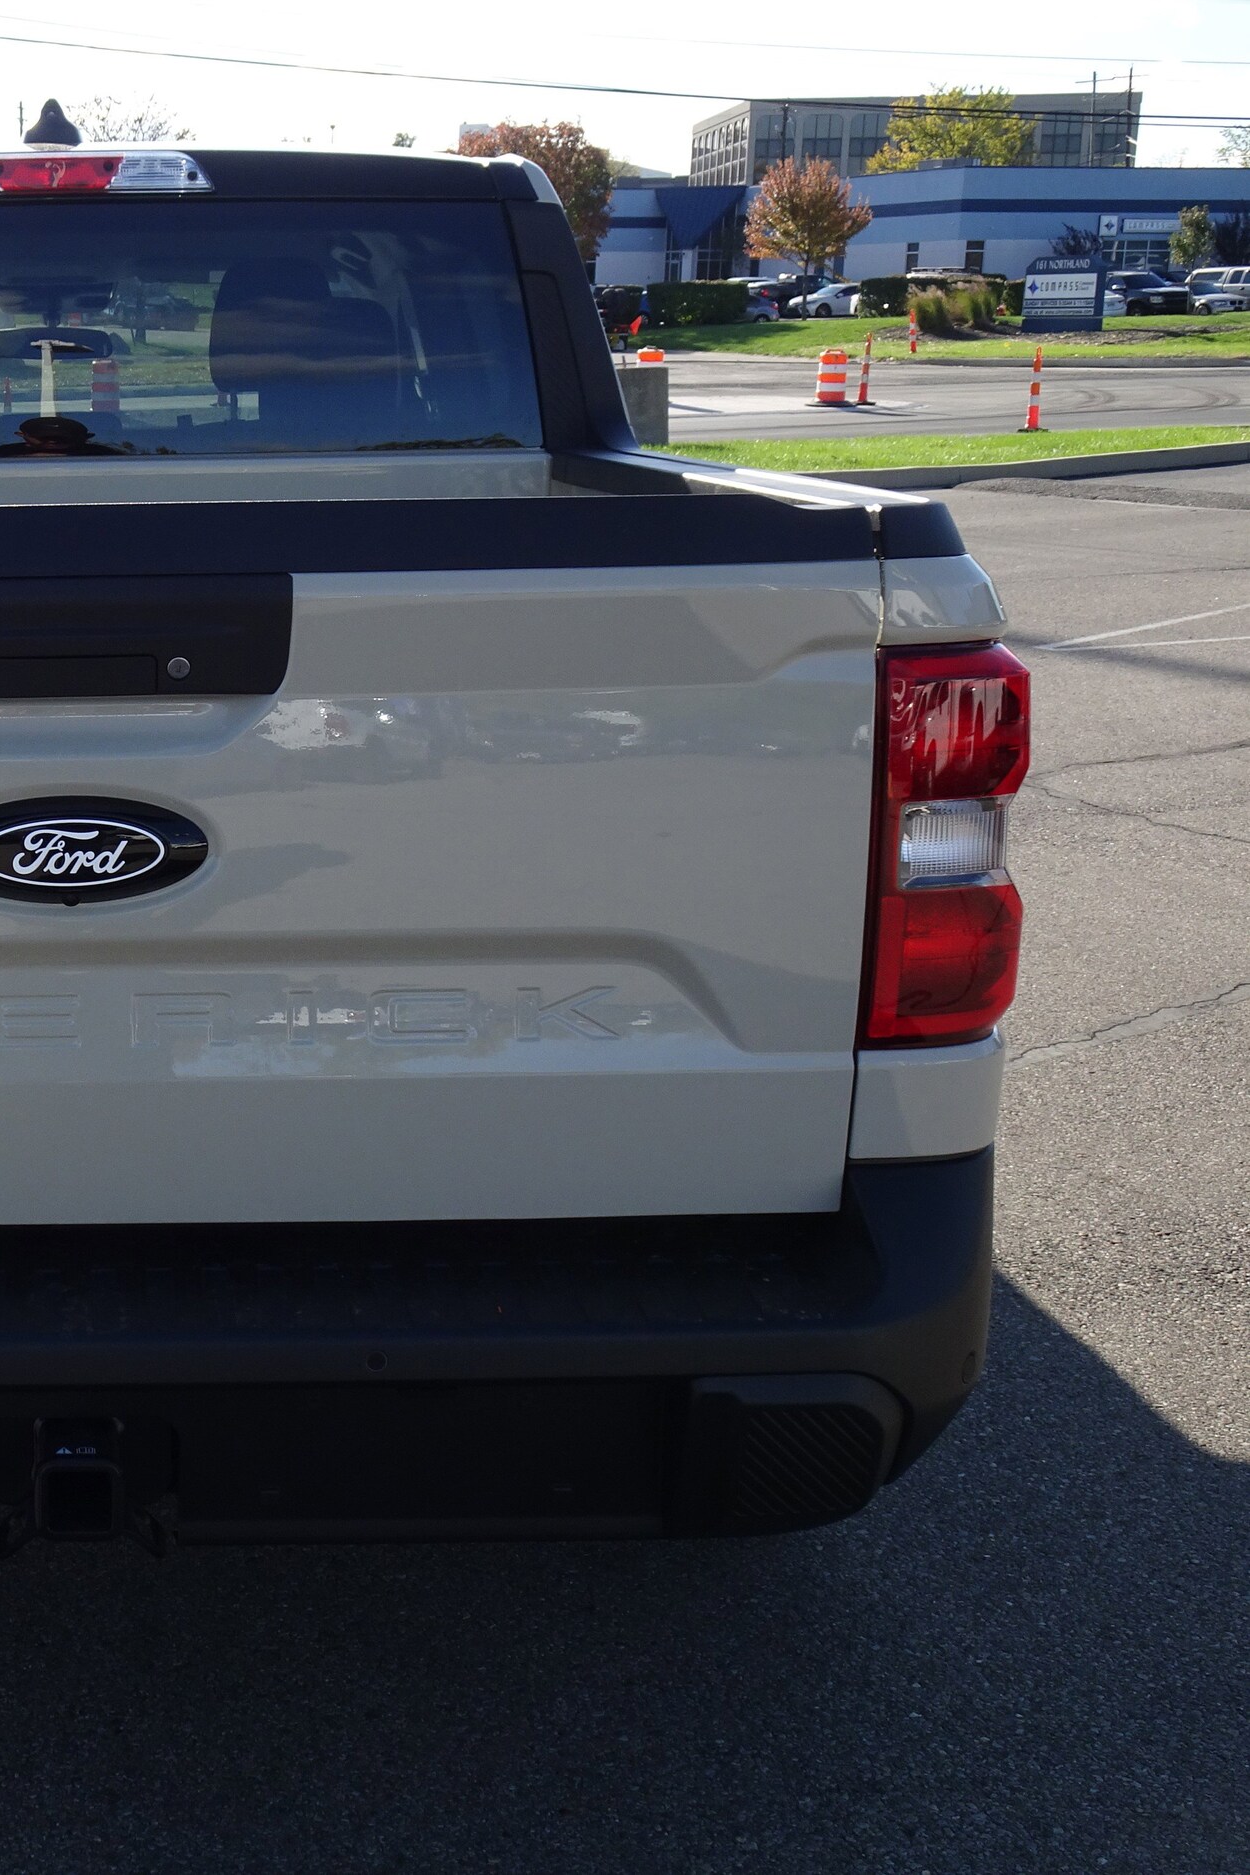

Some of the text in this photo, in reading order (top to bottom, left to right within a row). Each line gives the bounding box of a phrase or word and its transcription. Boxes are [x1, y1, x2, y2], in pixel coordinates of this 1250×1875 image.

[1036, 259, 1091, 270] 161 NORTHLAND
[1040, 281, 1079, 292] COMPASS
[13, 829, 129, 875] Ford
